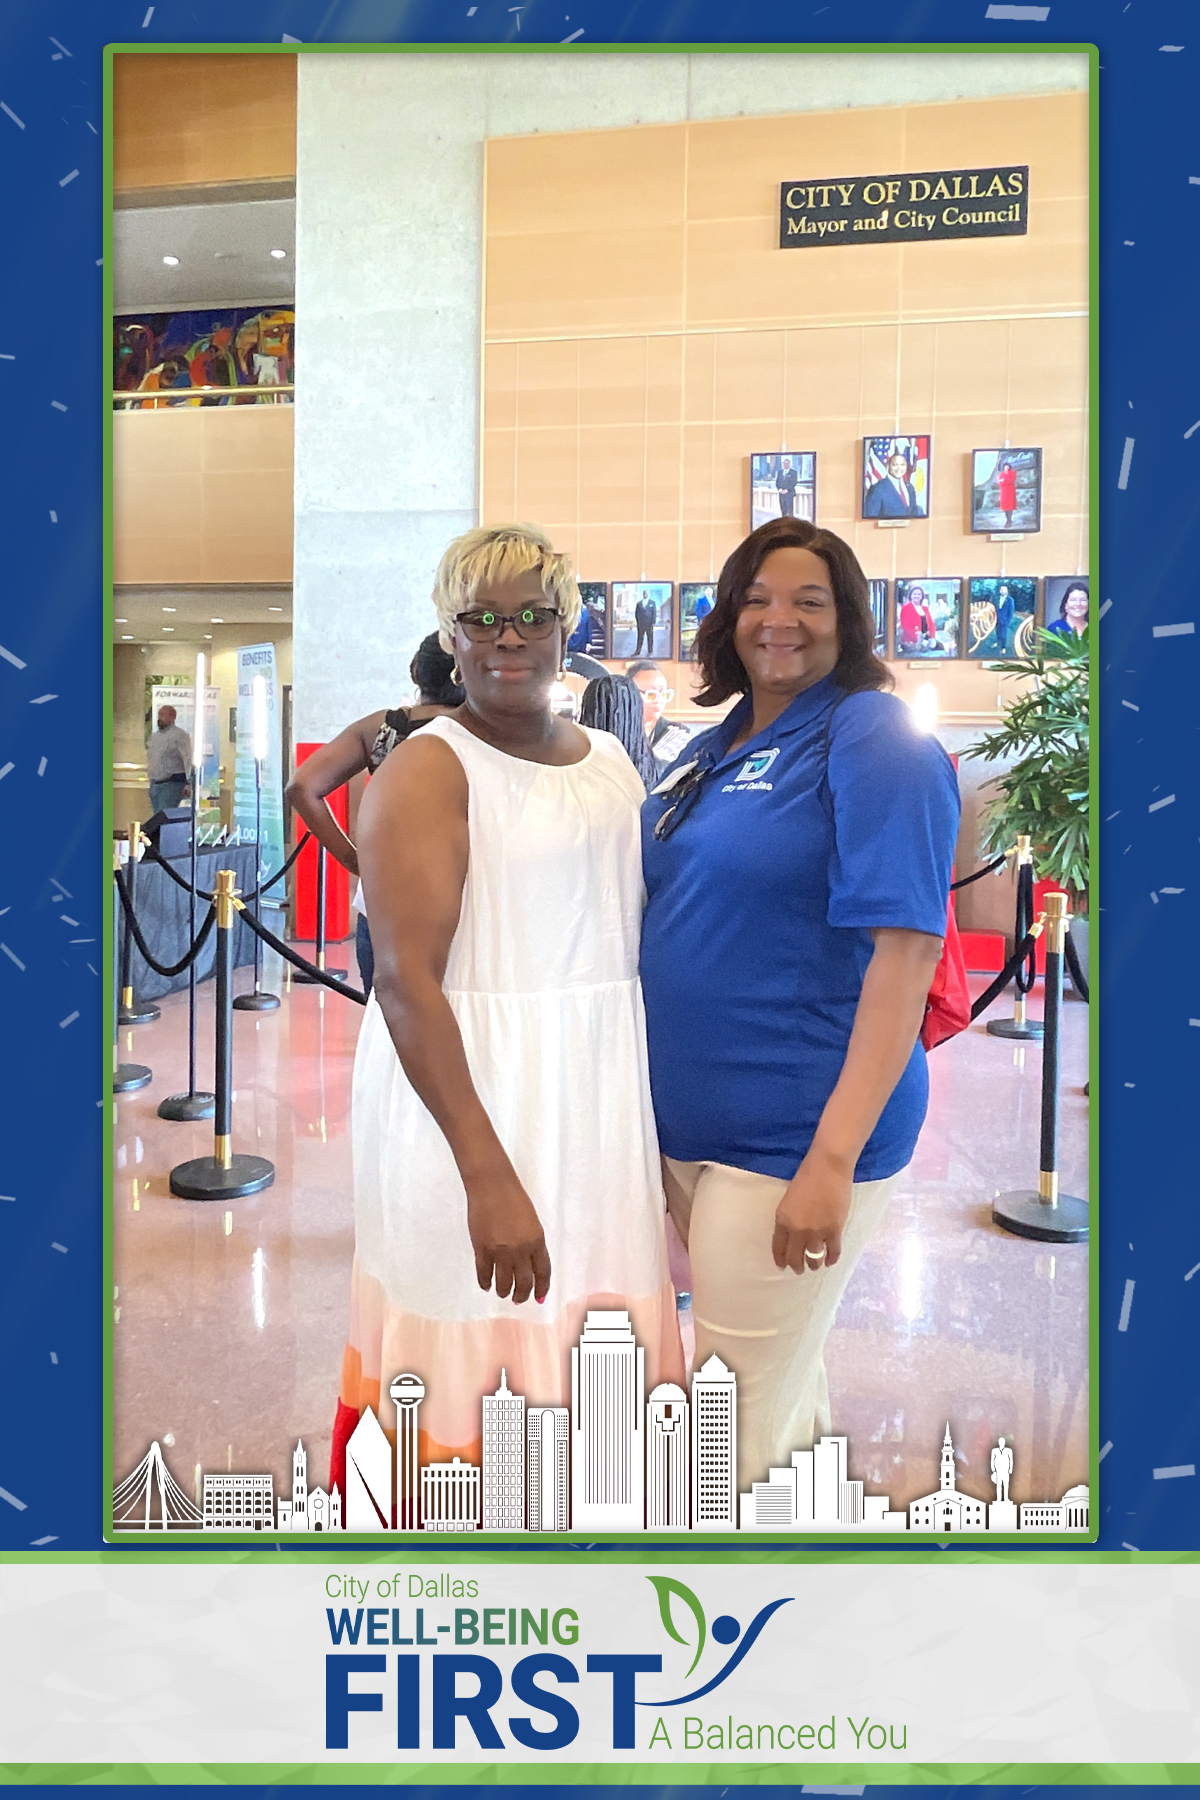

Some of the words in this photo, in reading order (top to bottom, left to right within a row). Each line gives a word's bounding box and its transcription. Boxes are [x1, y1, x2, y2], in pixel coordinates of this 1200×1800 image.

[786, 183, 856, 210] CITY
[863, 180, 902, 206] OF
[908, 172, 1024, 202] DALLAS
[787, 216, 849, 238] Mayor
[852, 209, 889, 231] and
[894, 210, 937, 231] City
[942, 202, 1021, 226] Council
[242, 650, 272, 667] BENEFITS
